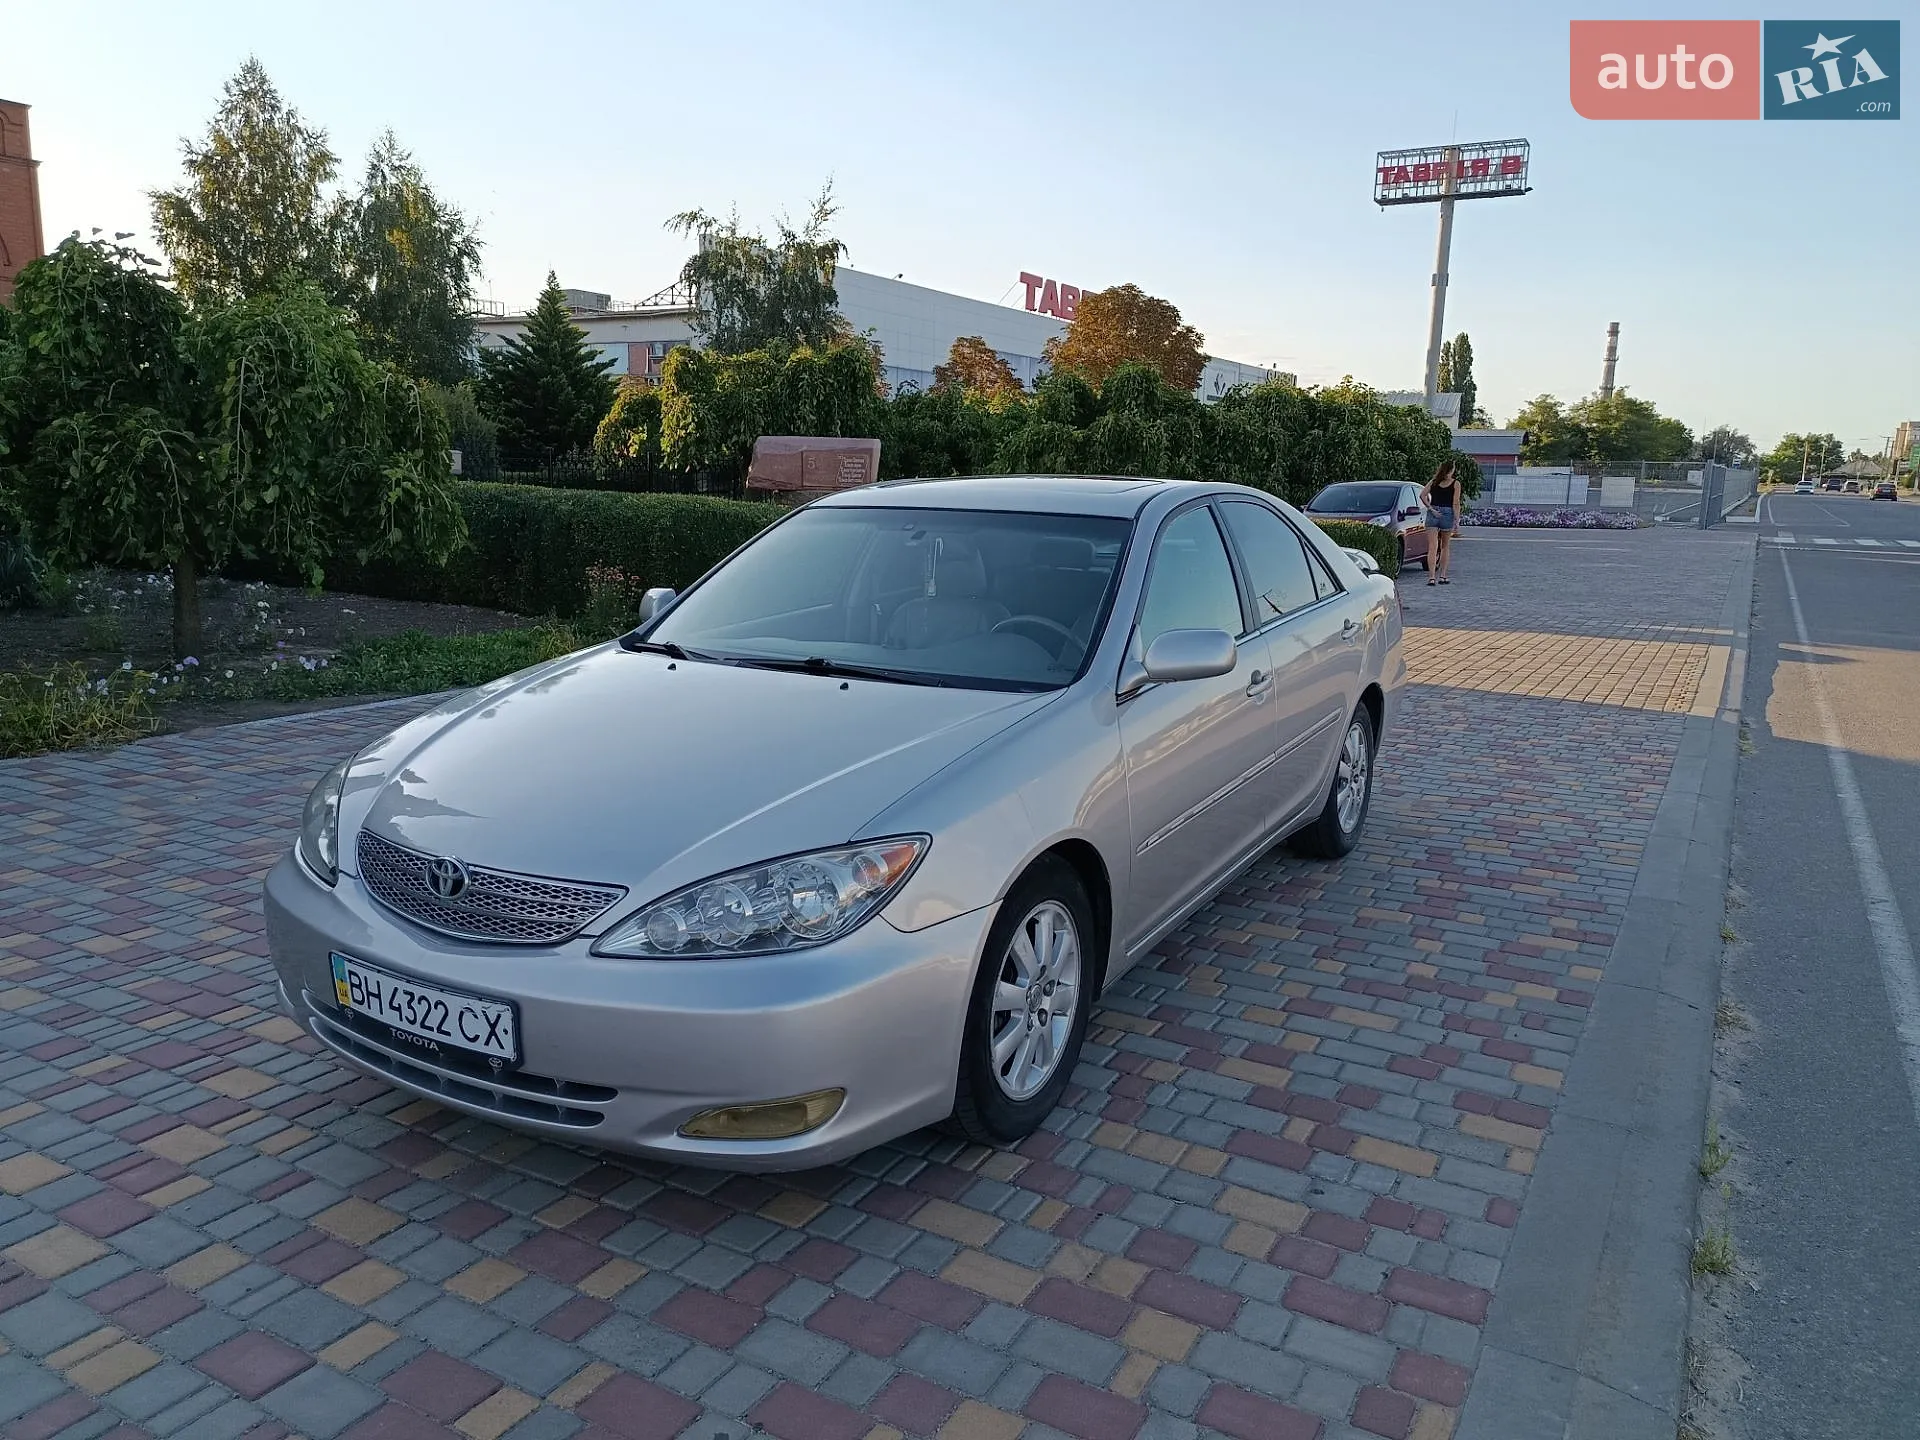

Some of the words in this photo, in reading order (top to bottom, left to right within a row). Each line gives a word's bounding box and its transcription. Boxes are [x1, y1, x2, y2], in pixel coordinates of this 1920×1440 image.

[1020, 271, 1101, 321] ТАВ
[348, 969, 383, 1015] BH
[388, 986, 451, 1037] 4322
[389, 1027, 440, 1051] TOYOTA
